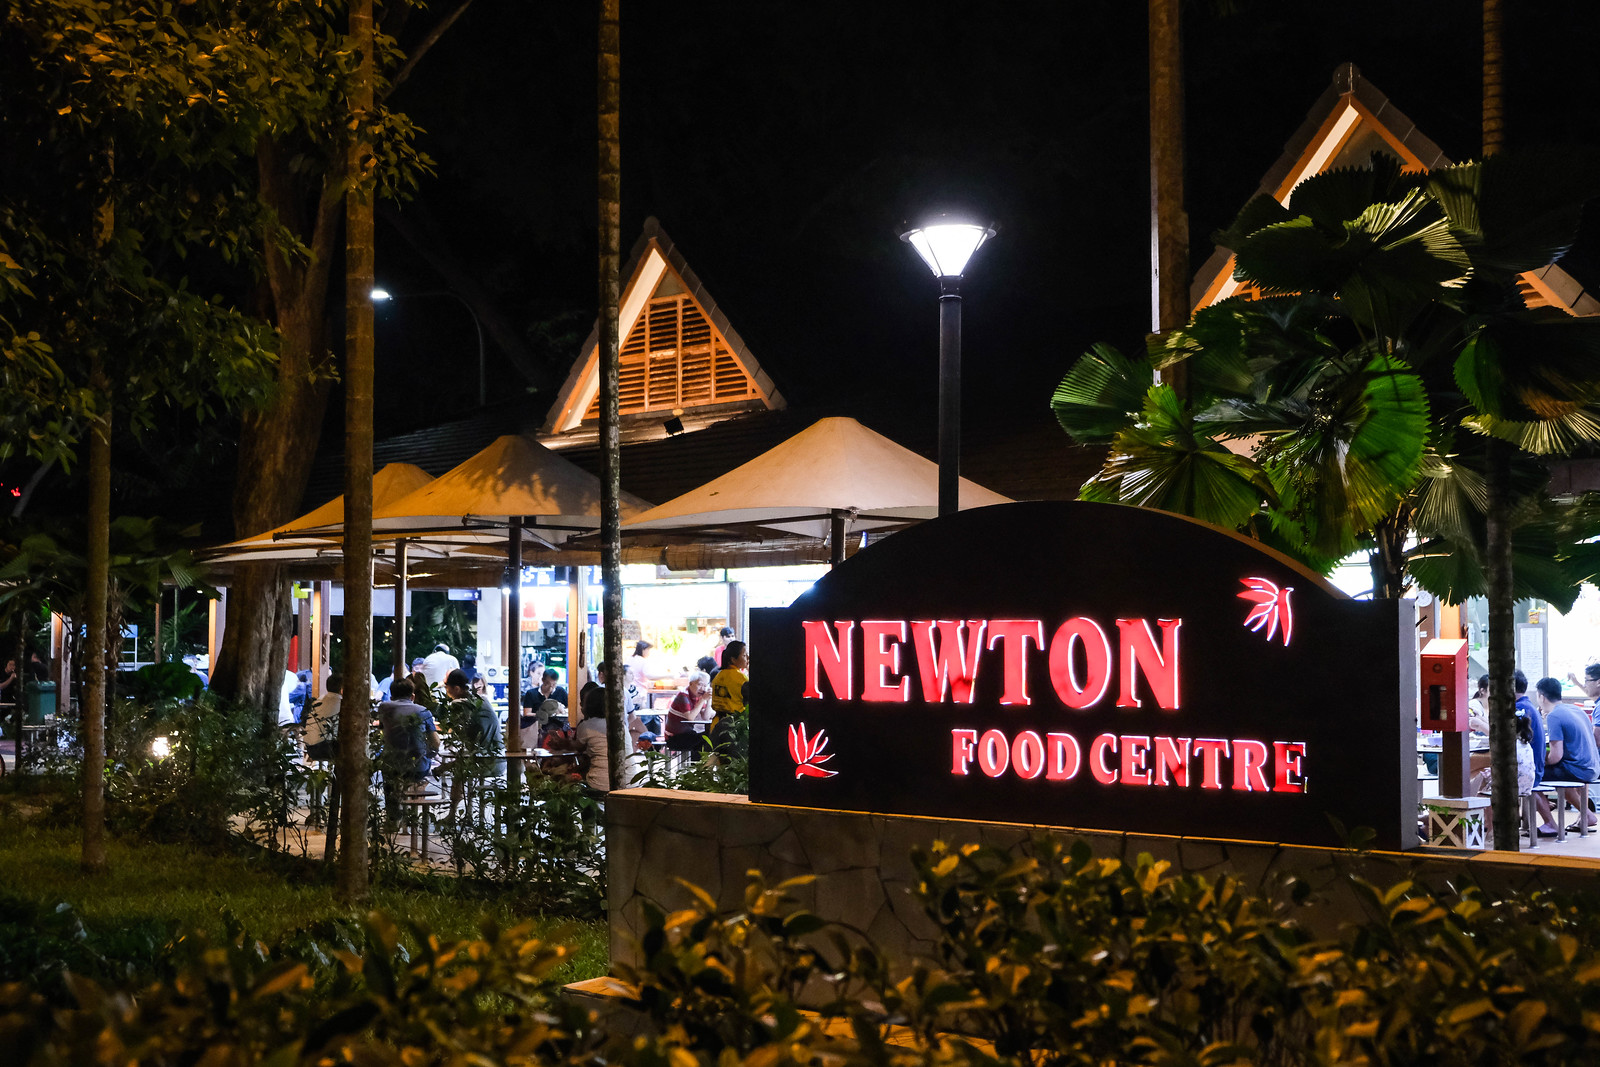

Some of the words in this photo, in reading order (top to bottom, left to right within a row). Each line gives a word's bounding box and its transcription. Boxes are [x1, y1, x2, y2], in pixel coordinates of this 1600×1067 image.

[802, 615, 1183, 711] NEWTON
[950, 727, 1082, 782] FOOD
[1089, 735, 1309, 794] CENTRE
